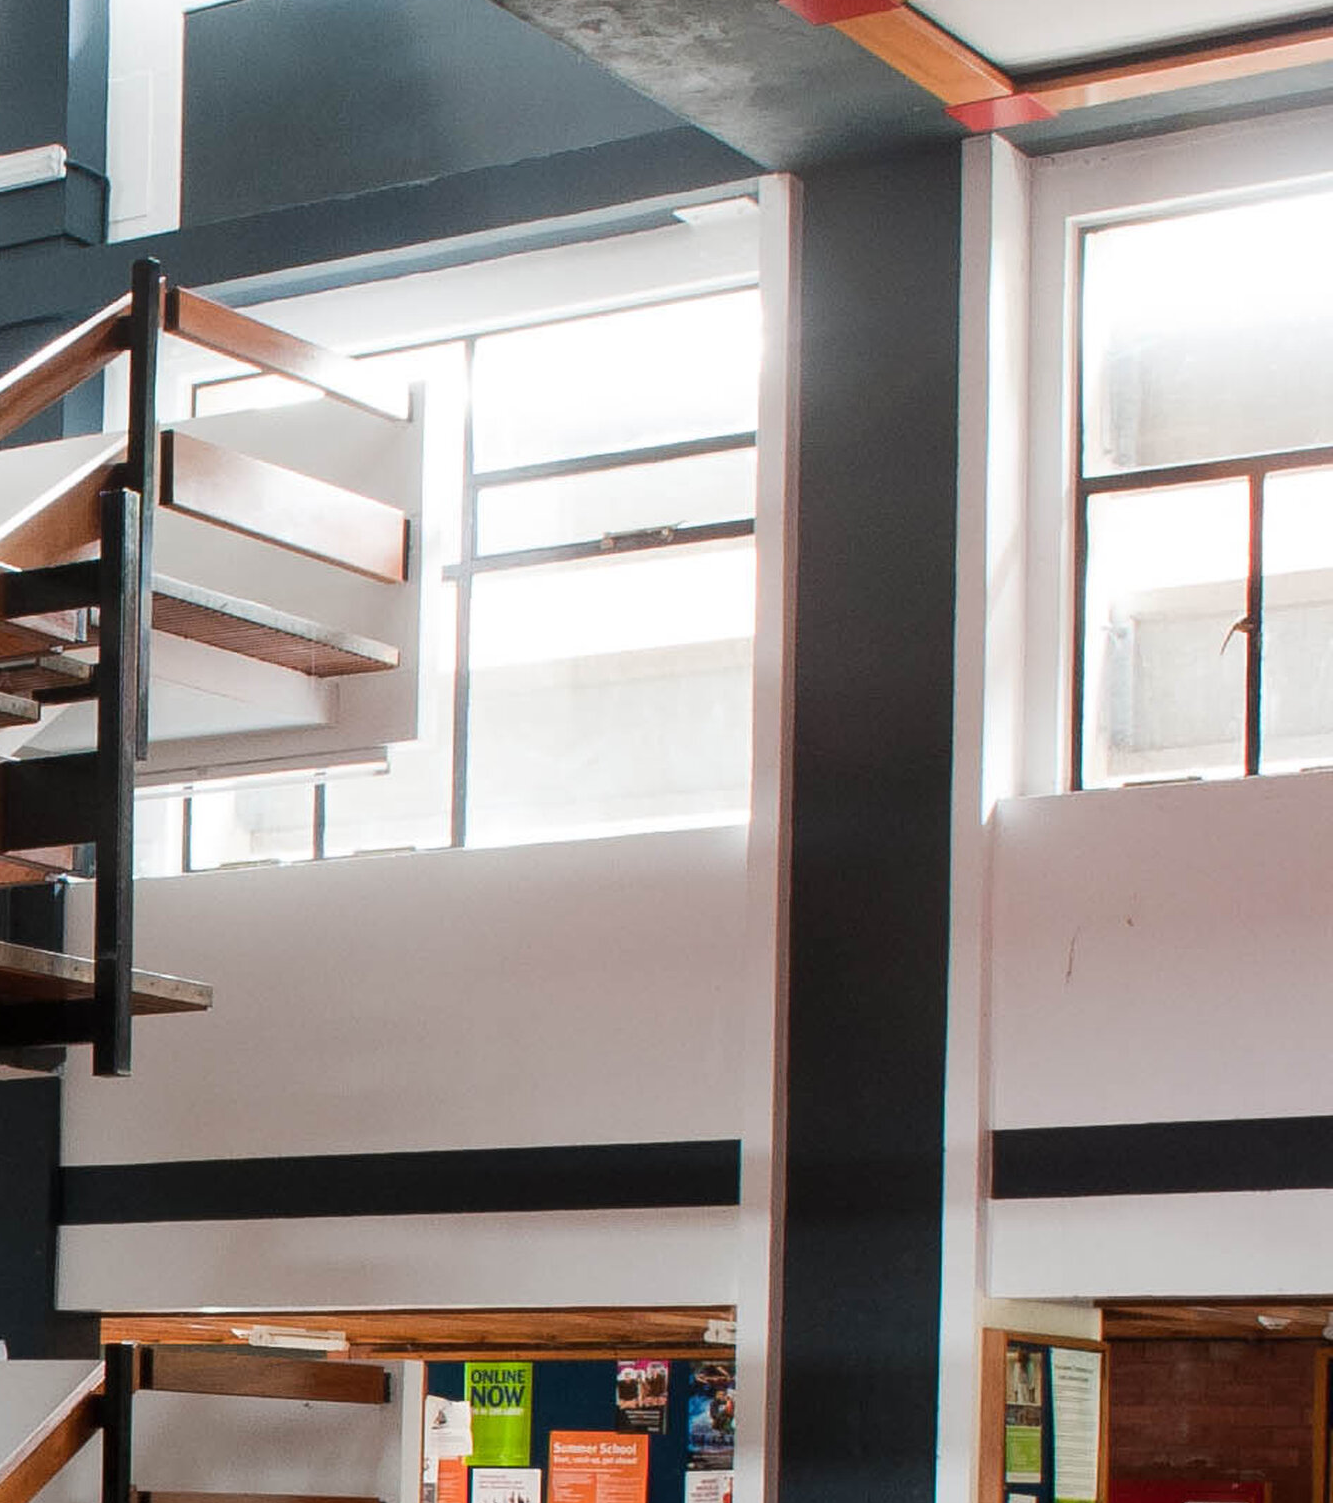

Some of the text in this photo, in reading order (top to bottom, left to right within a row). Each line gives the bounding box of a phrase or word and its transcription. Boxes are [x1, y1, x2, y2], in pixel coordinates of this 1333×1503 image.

[471, 1369, 526, 1384] ONLINE
[471, 1385, 525, 1407] NOW
[553, 1442, 637, 1455] Summer School
